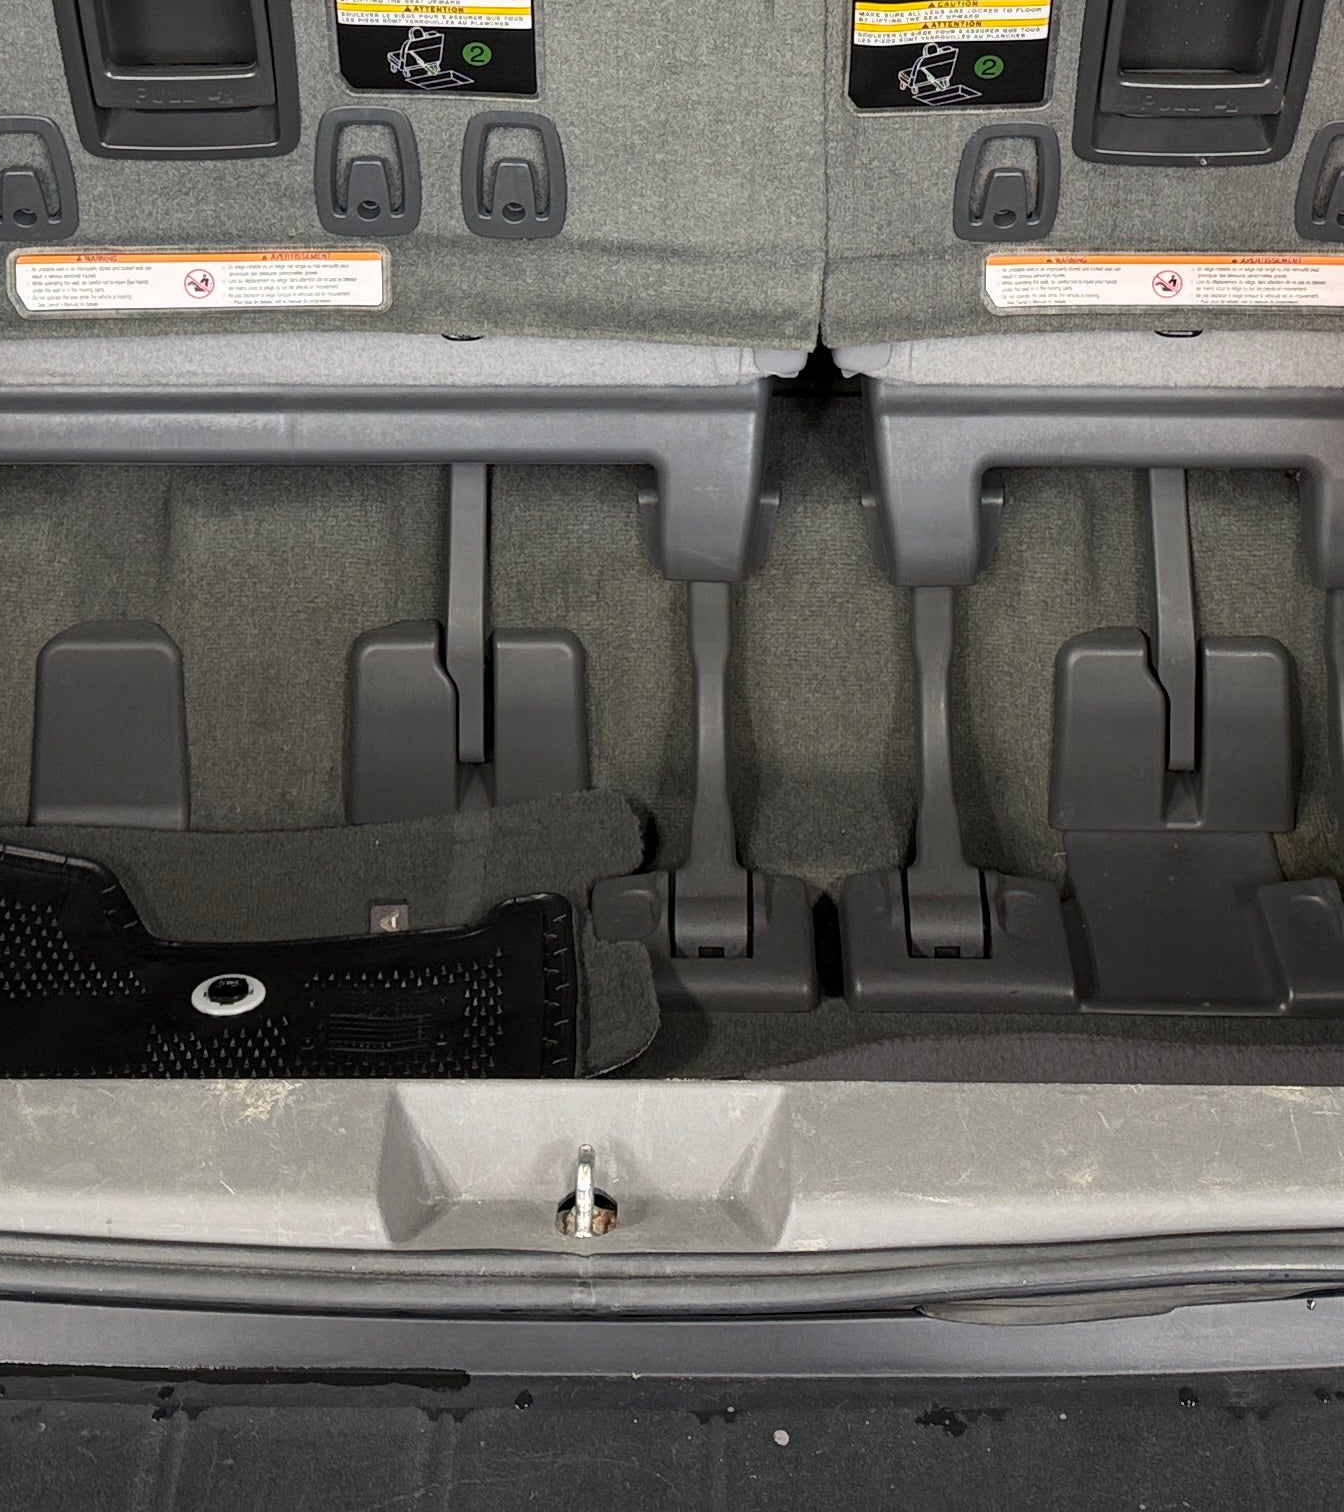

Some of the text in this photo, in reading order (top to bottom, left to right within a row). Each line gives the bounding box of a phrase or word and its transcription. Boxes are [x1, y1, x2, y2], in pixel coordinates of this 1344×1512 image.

[413, 5, 464, 13] ATTENTION
[931, 20, 982, 28] ATTENTION
[469, 46, 486, 63] 2
[981, 58, 997, 76] 2
